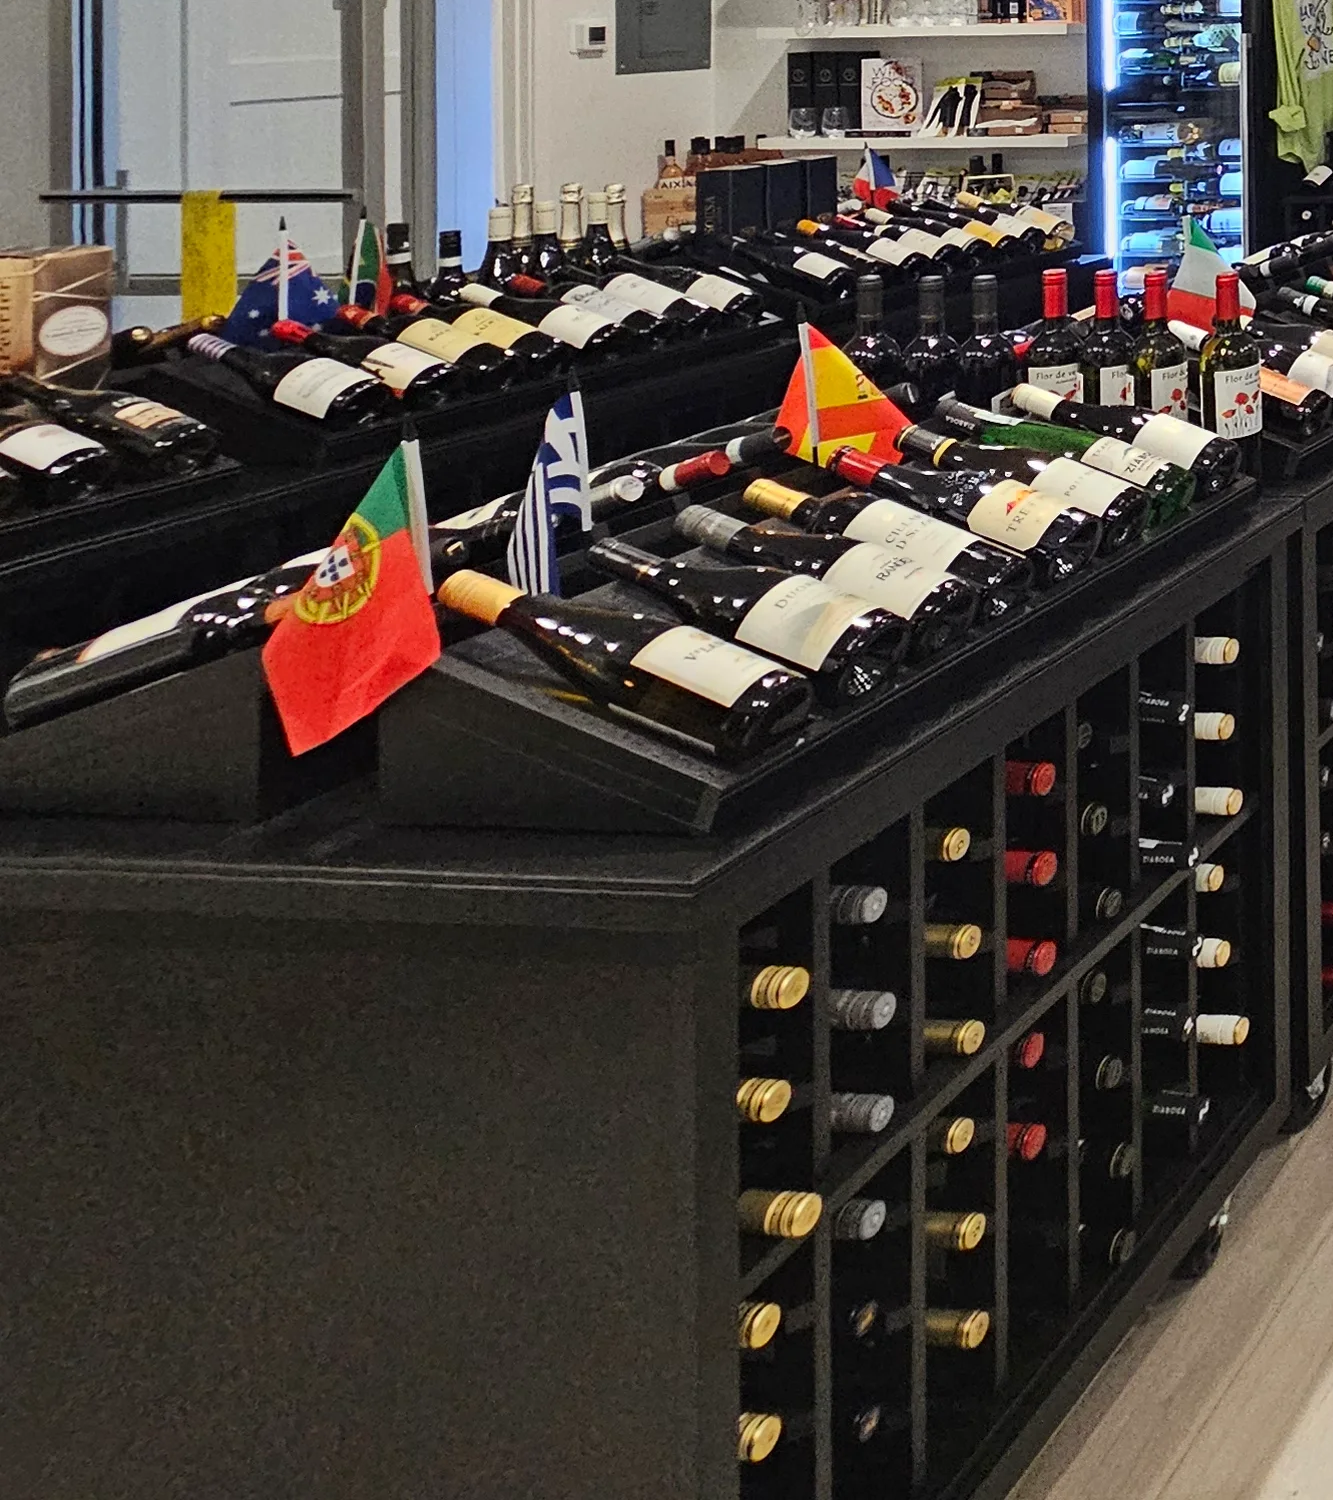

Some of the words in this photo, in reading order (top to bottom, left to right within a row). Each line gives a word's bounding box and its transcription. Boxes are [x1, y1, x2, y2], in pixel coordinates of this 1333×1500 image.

[660, 181, 681, 190] AIX
[1036, 372, 1052, 380] Flor
[1162, 372, 1177, 380] Flor
[1226, 376, 1244, 384] Flor
